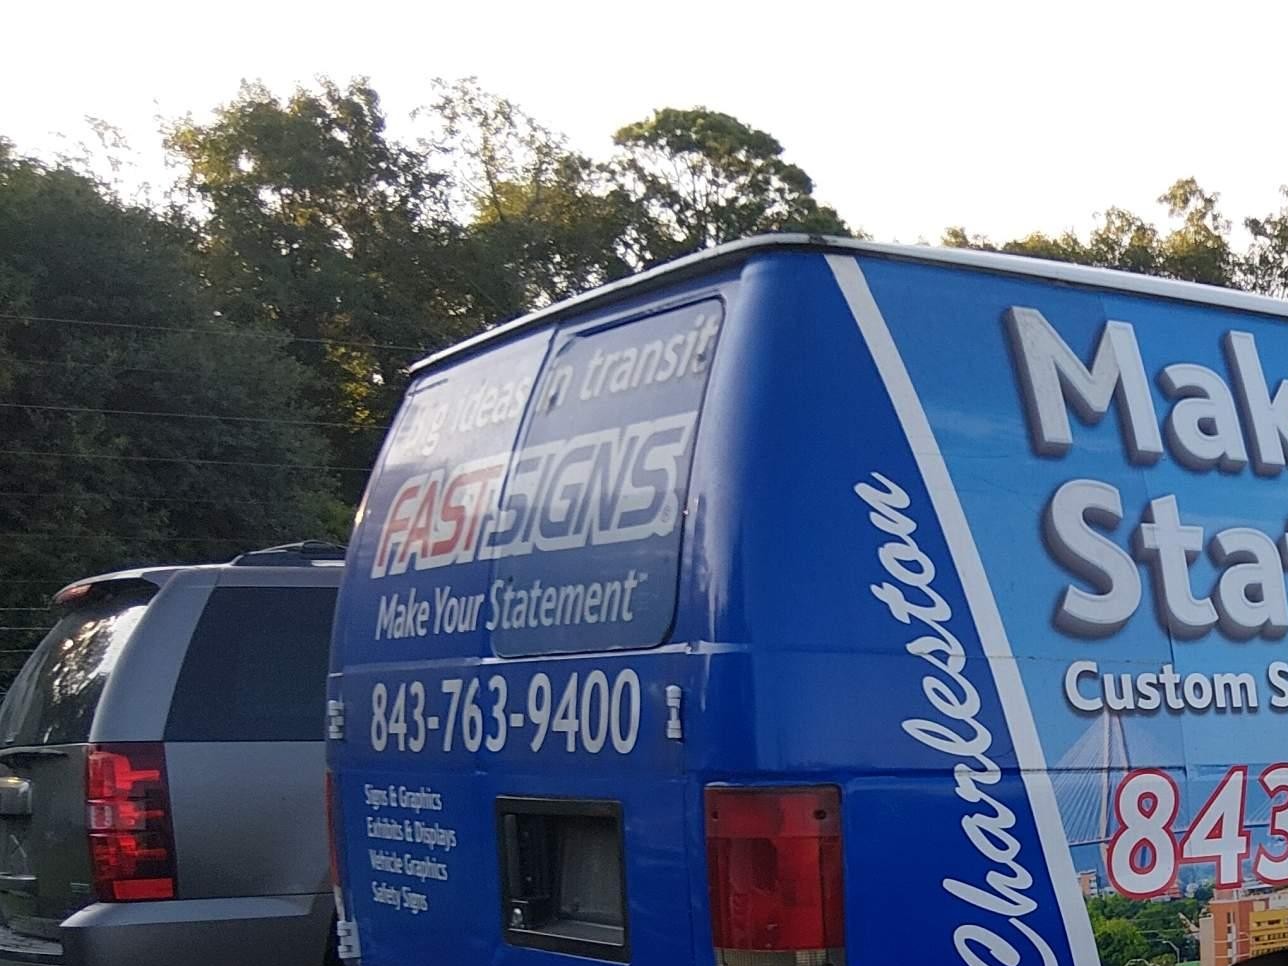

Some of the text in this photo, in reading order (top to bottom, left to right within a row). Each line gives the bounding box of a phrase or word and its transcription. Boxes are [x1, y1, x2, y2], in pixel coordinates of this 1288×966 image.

[450, 375, 531, 433] ideas
[580, 313, 718, 399] transit
[371, 410, 698, 579] FASTSIGNS
[375, 568, 638, 641] Make Your Statement
[370, 668, 641, 754] 843-763-9400
[1063, 659, 1260, 714] Custom
[364, 783, 389, 811] Signs
[398, 785, 443, 814] Graphics
[413, 820, 457, 852] Displays
[403, 853, 448, 883] Graphics
[402, 886, 429, 915] Signs
